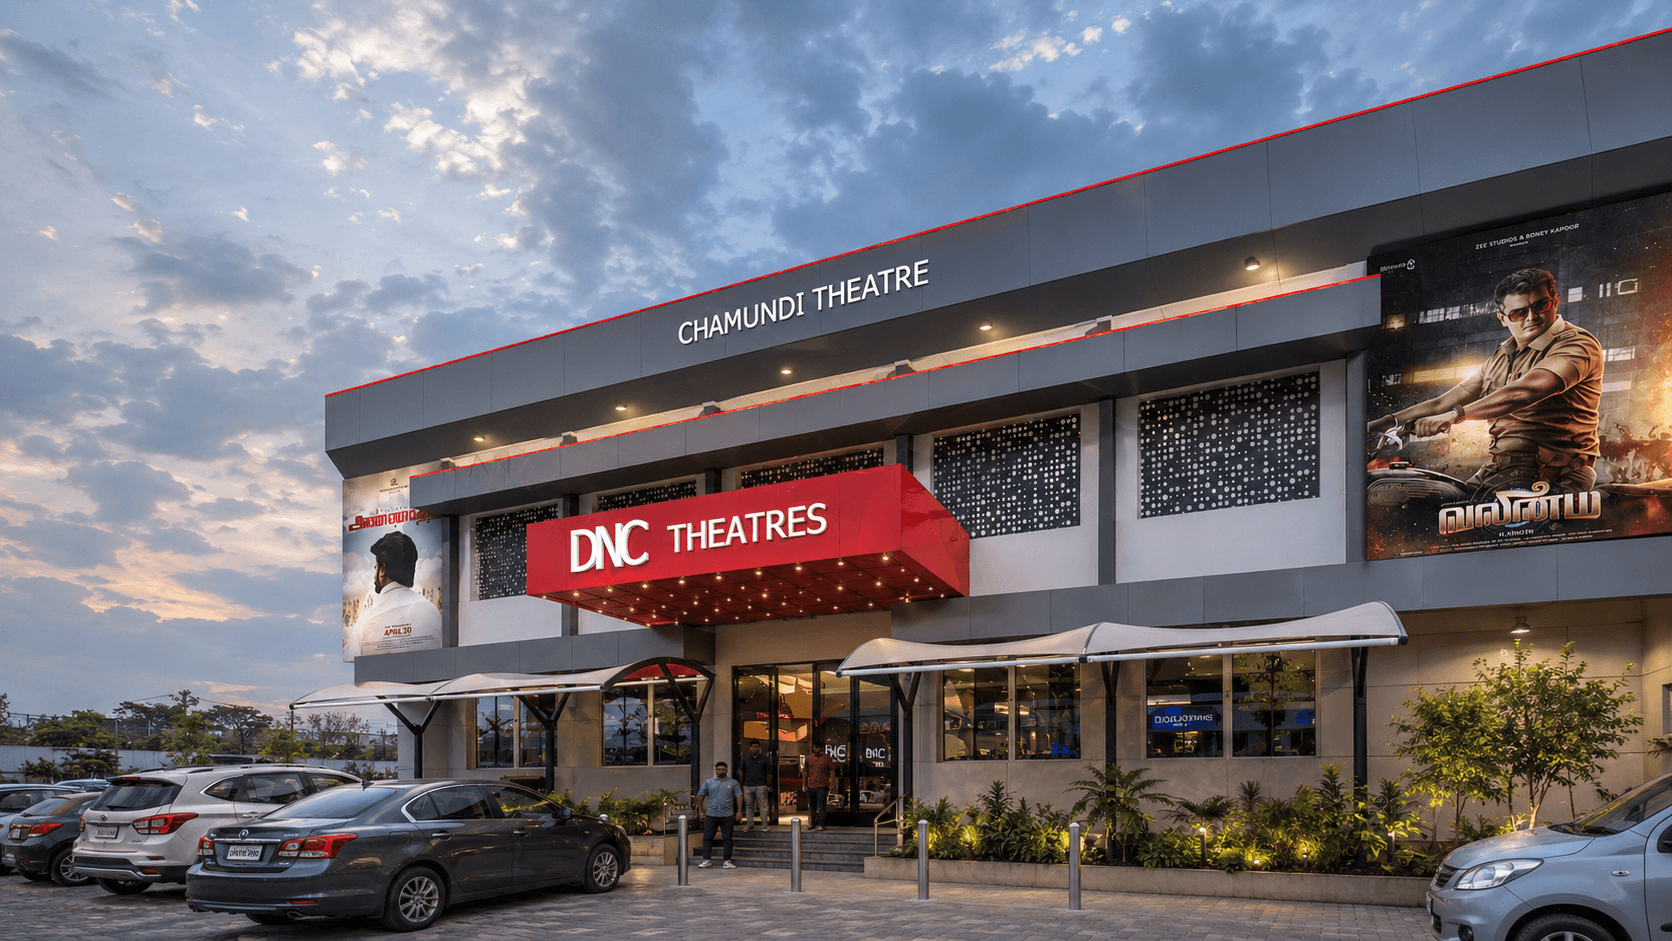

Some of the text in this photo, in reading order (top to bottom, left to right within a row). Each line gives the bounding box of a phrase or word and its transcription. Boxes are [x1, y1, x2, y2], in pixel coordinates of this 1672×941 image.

[1489, 236, 1518, 248] STUDIOS
[1525, 229, 1549, 240] BONEY
[1549, 223, 1580, 234] KAPOOR
[677, 259, 930, 345] CHAMUNDI THEATRE
[570, 503, 828, 574] DNC THEATRES
